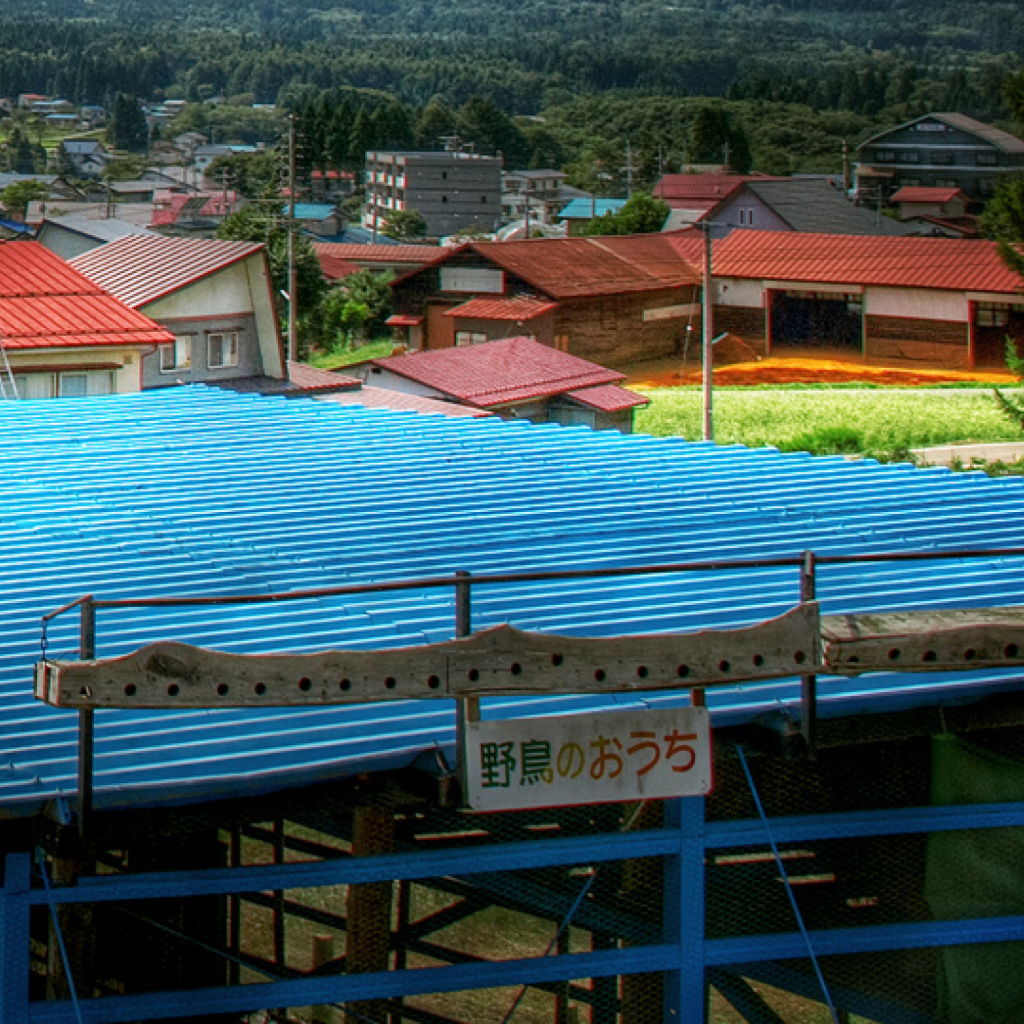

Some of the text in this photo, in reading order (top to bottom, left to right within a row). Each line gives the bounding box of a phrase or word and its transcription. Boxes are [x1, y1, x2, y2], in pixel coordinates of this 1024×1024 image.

[480, 729, 697, 787] 野鳥のおうち
